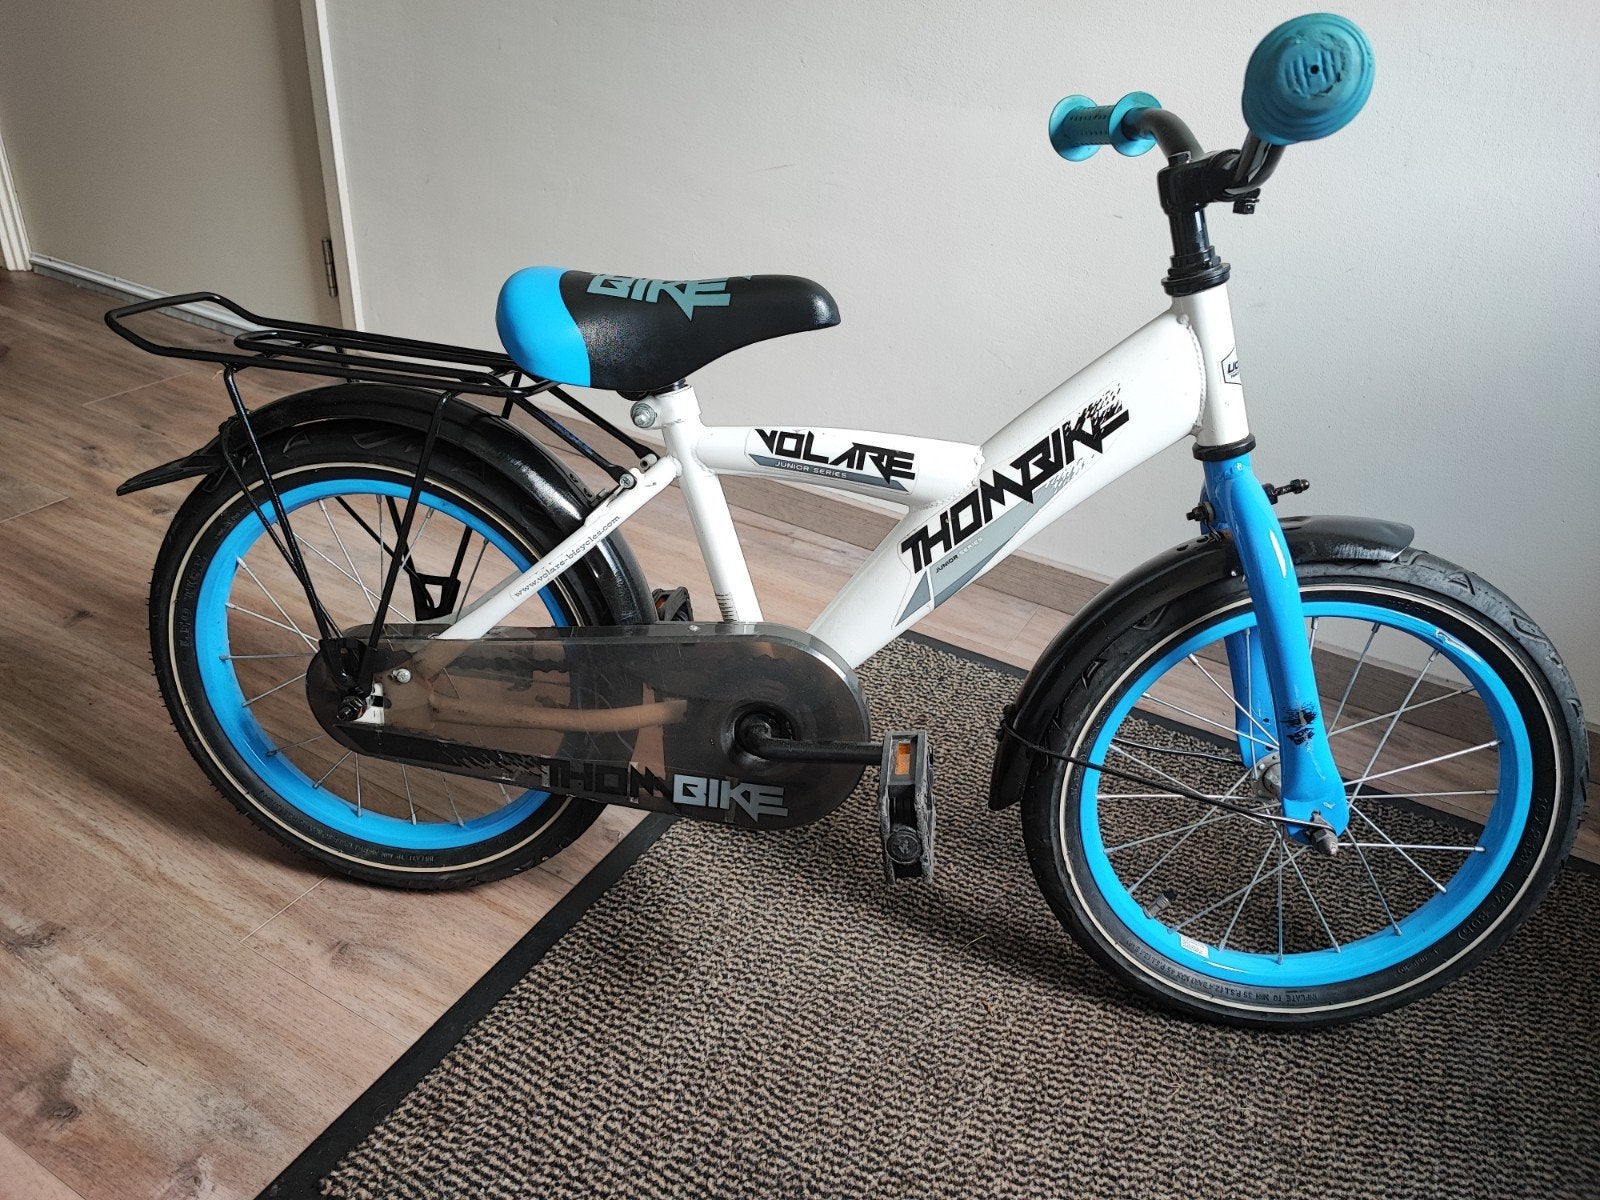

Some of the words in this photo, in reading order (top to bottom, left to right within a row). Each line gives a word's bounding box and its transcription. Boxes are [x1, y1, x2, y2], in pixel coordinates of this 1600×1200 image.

[586, 273, 731, 321] BIKE
[755, 428, 915, 484] VOLARE
[774, 461, 810, 472] JUNIOR
[813, 467, 848, 479] SERIES
[901, 402, 1130, 574] THOMBIKE
[514, 515, 621, 598] www.volare-bicycles.com
[935, 554, 959, 574] JUNIOR
